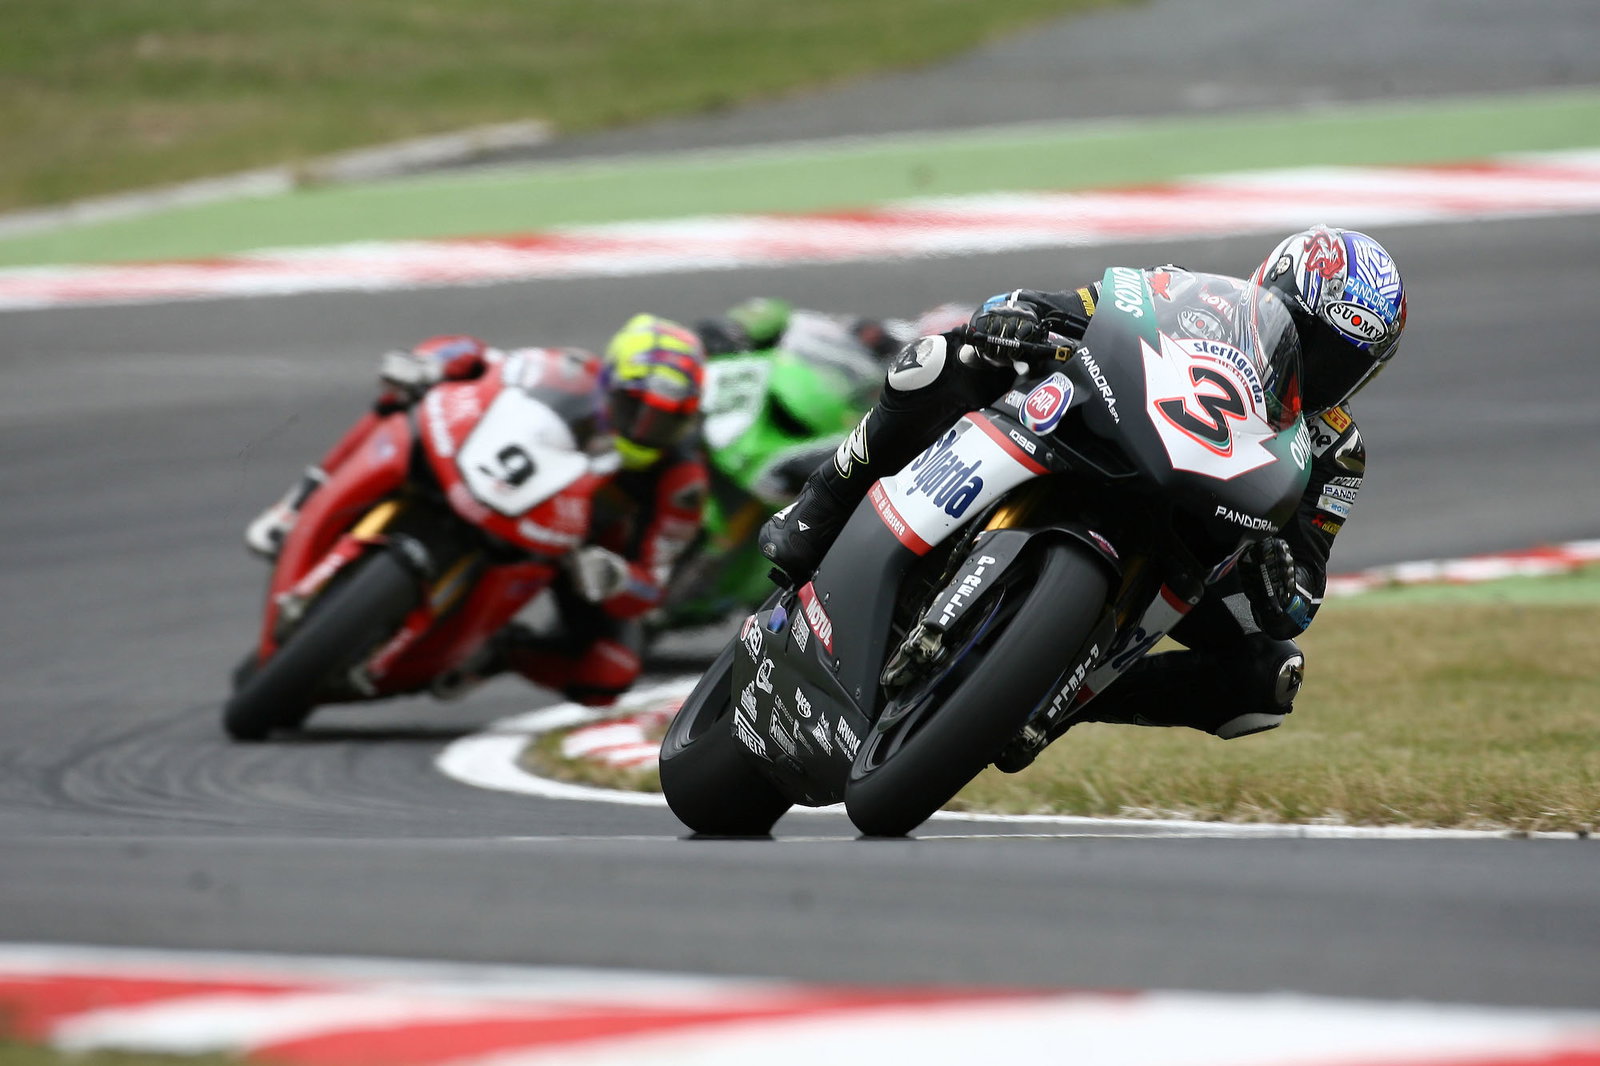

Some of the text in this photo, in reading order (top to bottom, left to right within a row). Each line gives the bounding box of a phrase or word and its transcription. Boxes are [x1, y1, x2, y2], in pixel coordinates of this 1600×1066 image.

[1112, 267, 1144, 319] OIKOS
[1345, 278, 1389, 313] PANDORA
[1334, 302, 1382, 341] SUOMY
[1077, 346, 1117, 414] PANDORA
[1193, 340, 1264, 404] sterilgarda
[1028, 387, 1057, 417] PATA
[1154, 365, 1247, 458] 3
[1009, 428, 1037, 456] 1098
[477, 445, 537, 487] 9
[1324, 485, 1357, 500] PANDO
[1214, 505, 1272, 532] PANDORA
[938, 555, 996, 627] PIRELLI
[805, 596, 833, 648] MOTUL
[1047, 643, 1100, 719] PIRELLI
